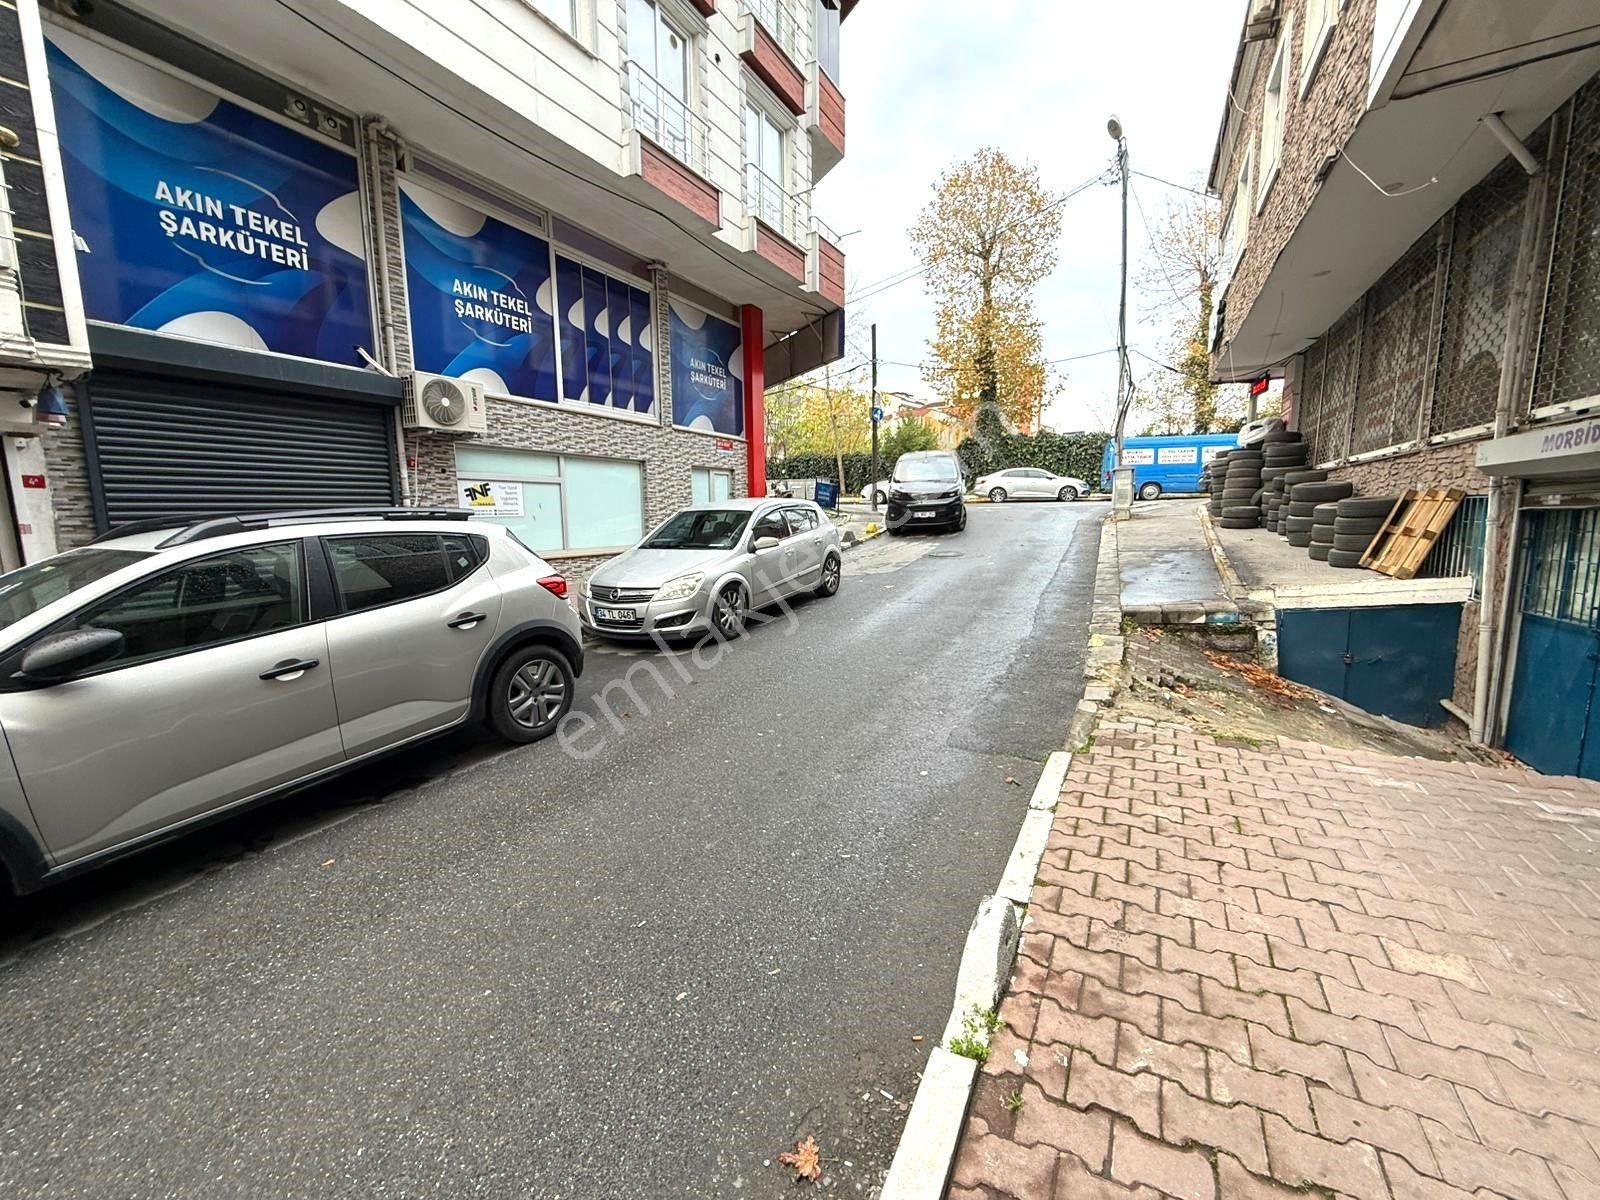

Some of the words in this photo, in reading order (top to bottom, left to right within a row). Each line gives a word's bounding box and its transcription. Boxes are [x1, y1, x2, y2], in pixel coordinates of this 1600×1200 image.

[154, 180, 224, 221] AKIN
[229, 203, 309, 247] TEKEL
[159, 209, 309, 271] ŞARKÜTERİ
[453, 278, 488, 303] AKIN
[490, 290, 533, 317] TEKEL
[454, 298, 533, 334] ŞARKÜTERİ
[689, 358, 706, 372] AKIN
[706, 363, 727, 379] TEKEL
[690, 371, 727, 390] ŞARKÜTERİ
[598, 608, 607, 618] 34
[608, 609, 616, 619] TL
